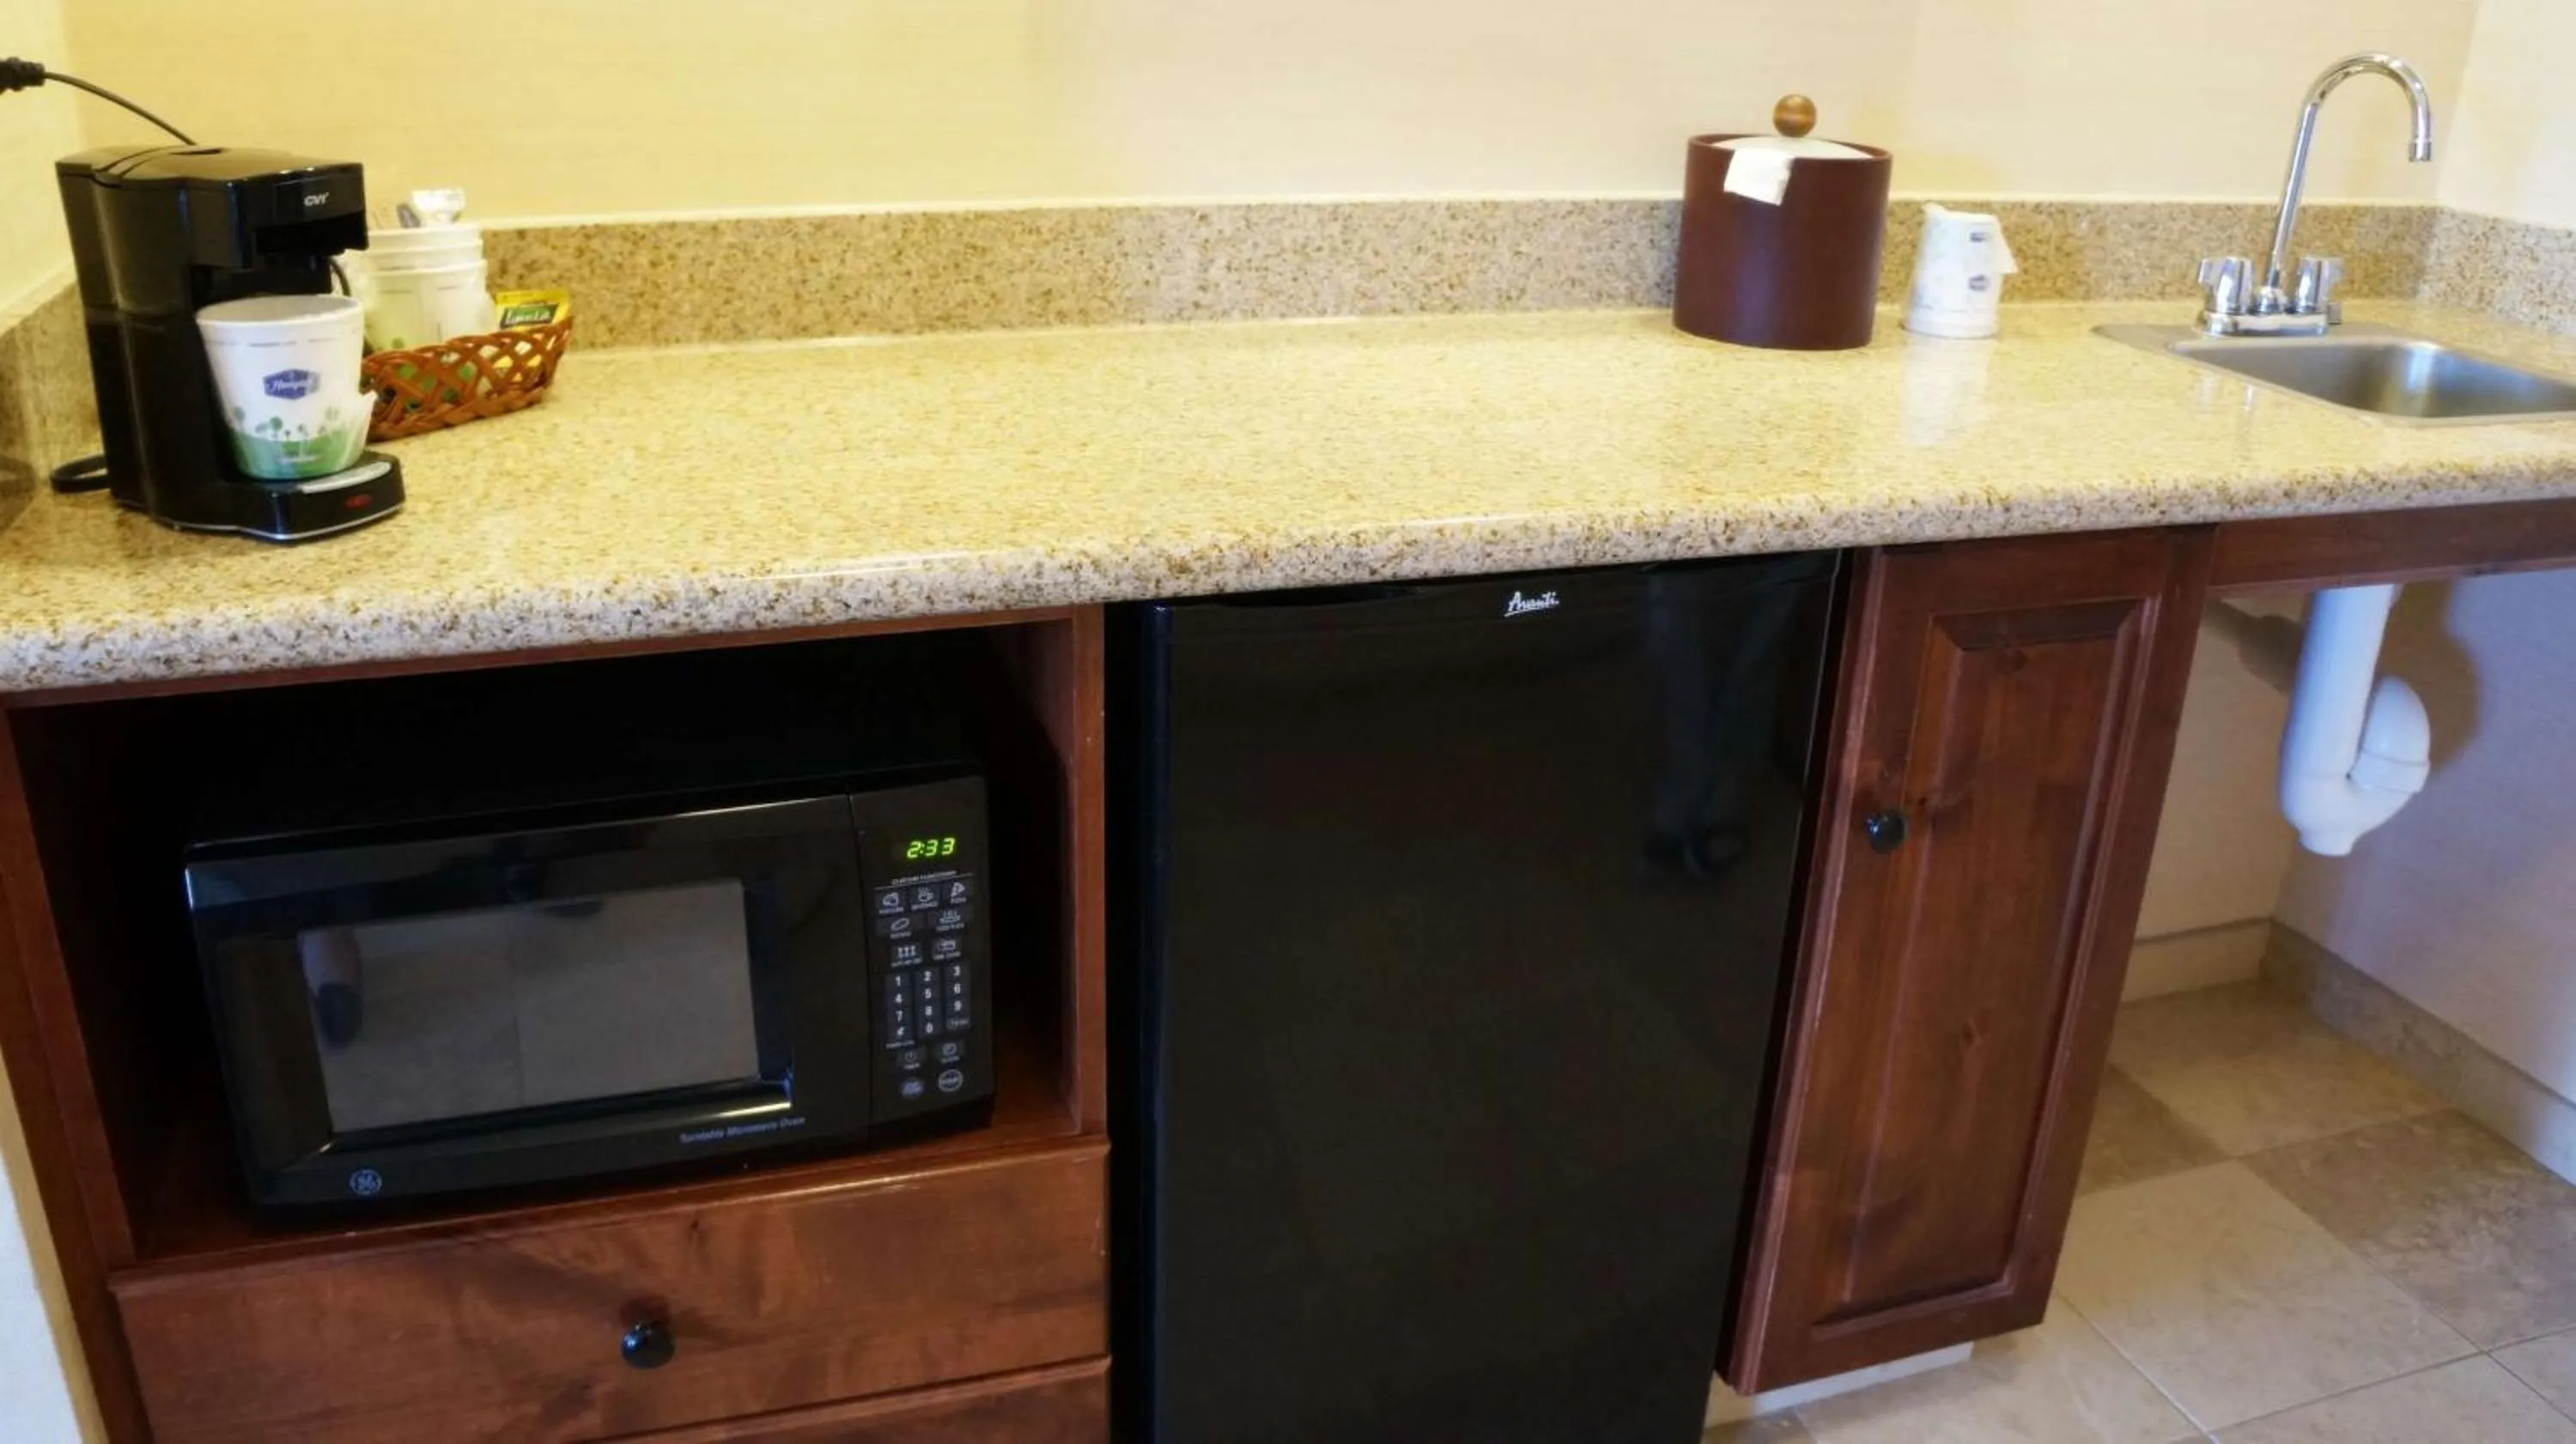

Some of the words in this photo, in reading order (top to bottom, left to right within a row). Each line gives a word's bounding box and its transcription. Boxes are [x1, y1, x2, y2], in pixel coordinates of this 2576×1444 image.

[1505, 591, 1558, 615] Avanti
[906, 837, 956, 859] 2:33
[895, 975, 902, 986] 1
[924, 971, 932, 981] 2
[953, 965, 961, 976] 3
[895, 993, 902, 1004] 4
[925, 988, 932, 998] 5
[954, 983, 961, 994] 6
[896, 1010, 902, 1022] 7
[925, 1005, 933, 1016] 8
[954, 1000, 962, 1011] 9
[926, 1022, 933, 1034] 0
[780, 1117, 805, 1128] Oven
